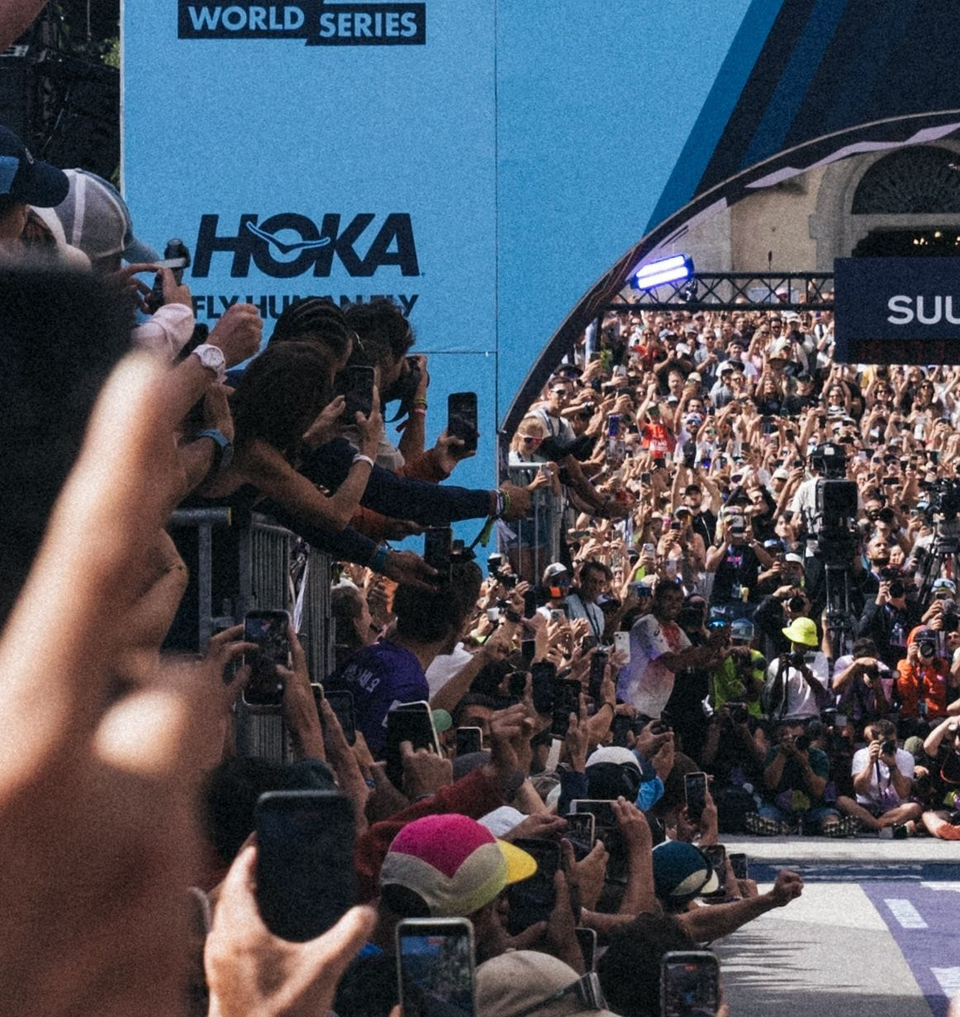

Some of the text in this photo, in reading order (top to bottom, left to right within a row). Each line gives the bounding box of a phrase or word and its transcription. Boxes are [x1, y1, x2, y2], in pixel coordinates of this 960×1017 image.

[188, 5, 418, 38] WORLD SERIES
[191, 212, 420, 279] HOKA
